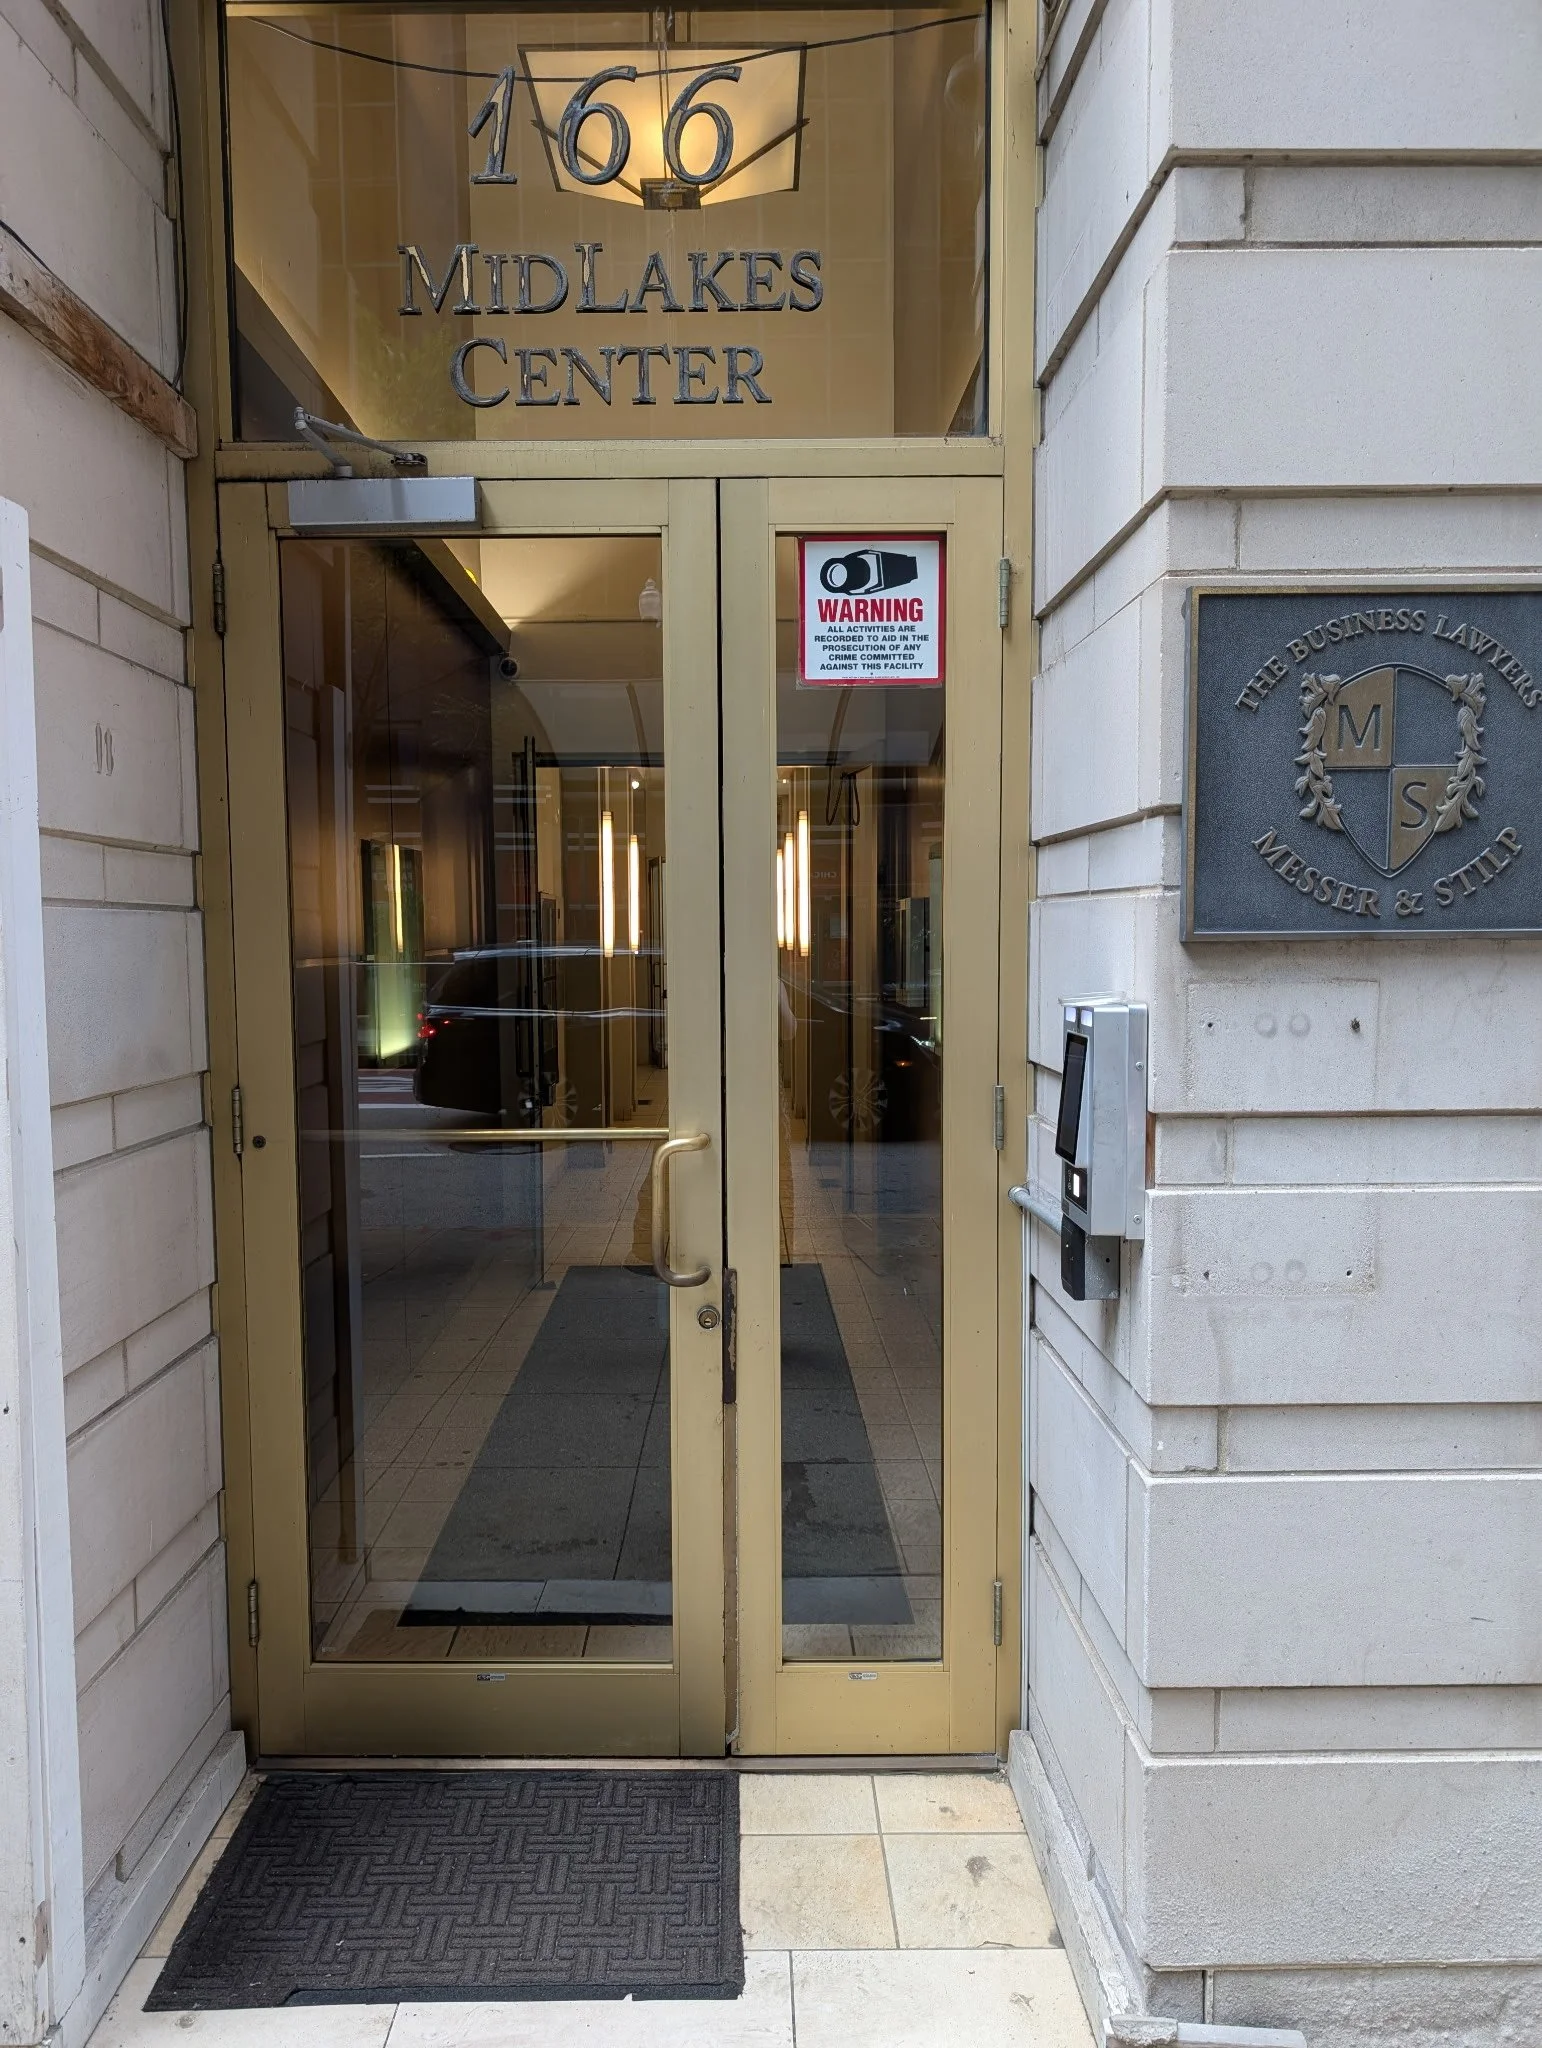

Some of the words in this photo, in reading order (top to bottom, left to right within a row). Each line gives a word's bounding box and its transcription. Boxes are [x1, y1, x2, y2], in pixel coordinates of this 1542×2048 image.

[467, 65, 742, 186] 166
[449, 337, 773, 407] CENTER
[817, 598, 923, 623] WARNING
[846, 625, 895, 633] ACTIVITIES
[828, 653, 857, 661] CRIME
[860, 653, 915, 661] COMMITTED
[899, 634, 909, 642] IN
[911, 634, 929, 642] THE
[1234, 655, 1289, 714] THE
[1285, 608, 1427, 663] BUSINESS
[1432, 614, 1542, 709] LAWYERS
[820, 663, 858, 671] AGAINST
[884, 662, 924, 670] FACILITY
[1337, 703, 1383, 751] M
[1400, 781, 1428, 829] S
[1251, 826, 1381, 917] MESSER
[1394, 889, 1424, 916] &
[1433, 827, 1523, 906] STILP
